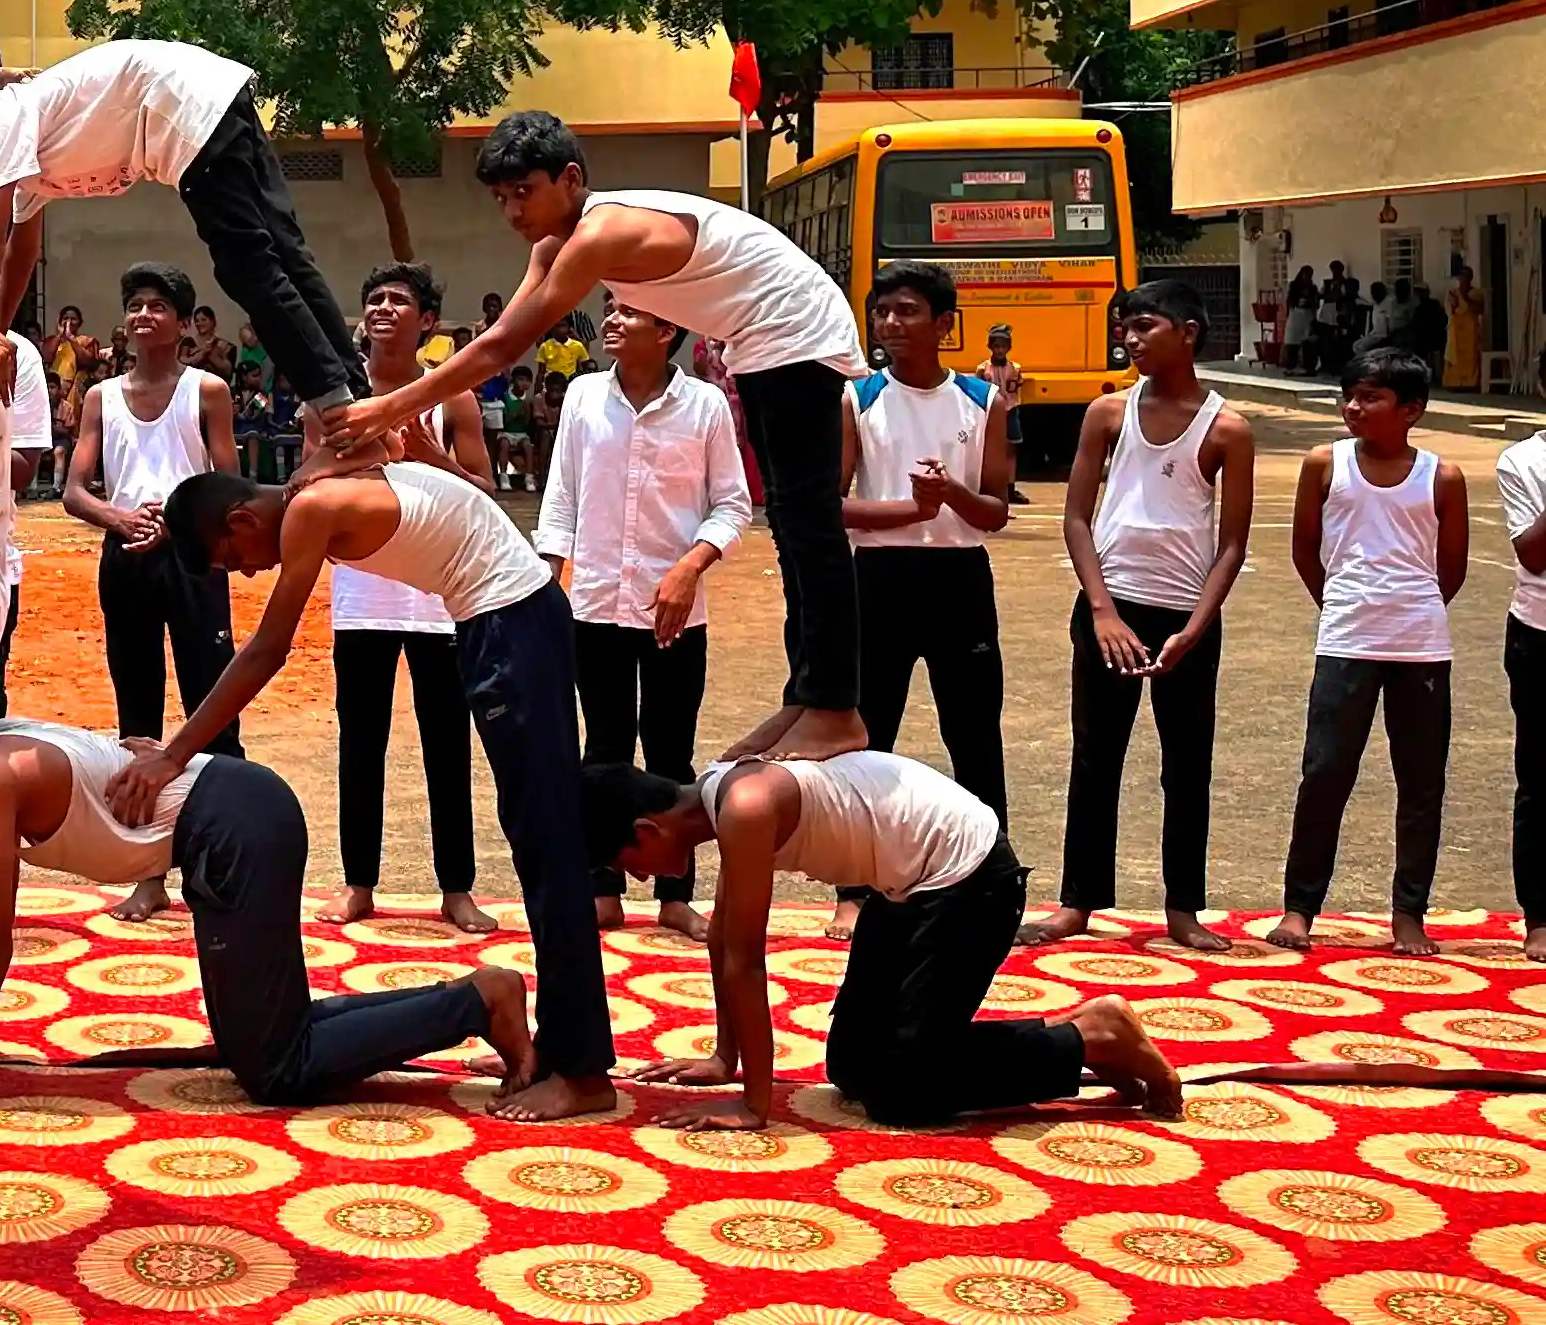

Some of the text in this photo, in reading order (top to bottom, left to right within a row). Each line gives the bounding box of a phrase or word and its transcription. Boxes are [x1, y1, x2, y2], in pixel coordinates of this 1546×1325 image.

[950, 206, 1051, 222] ADMISSIONS OPEN
[1080, 216, 1089, 229] 1
[1010, 260, 1047, 269] VIDYA
[1058, 259, 1096, 267] VIHAR
